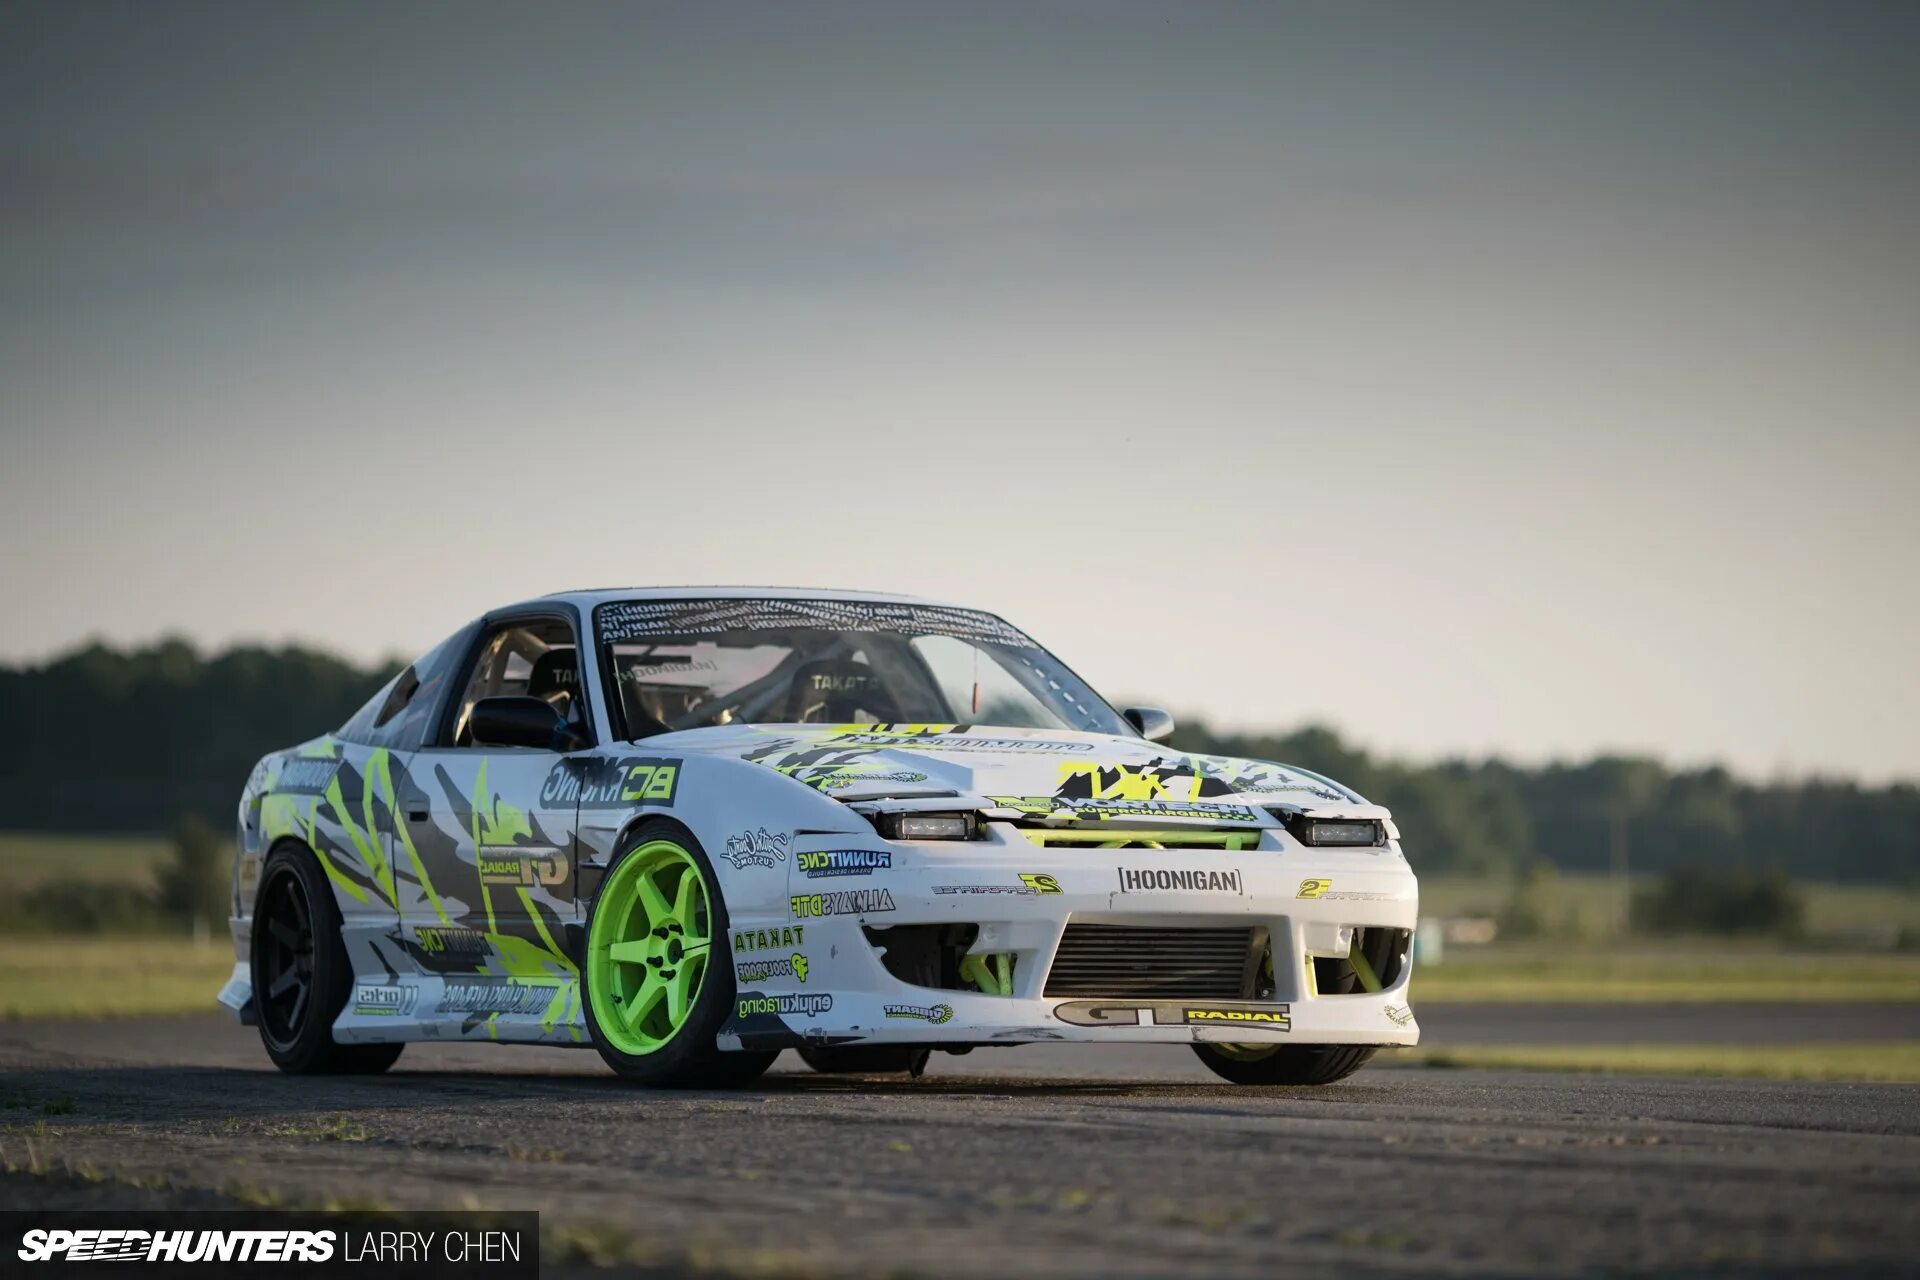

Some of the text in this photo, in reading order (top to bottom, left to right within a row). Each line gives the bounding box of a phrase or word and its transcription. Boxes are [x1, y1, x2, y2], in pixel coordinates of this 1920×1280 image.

[1057, 796, 1250, 815] VORTECH
[1074, 807, 1220, 820] SUPERCHARGERS
[1188, 1010, 1290, 1022] RADIAL
